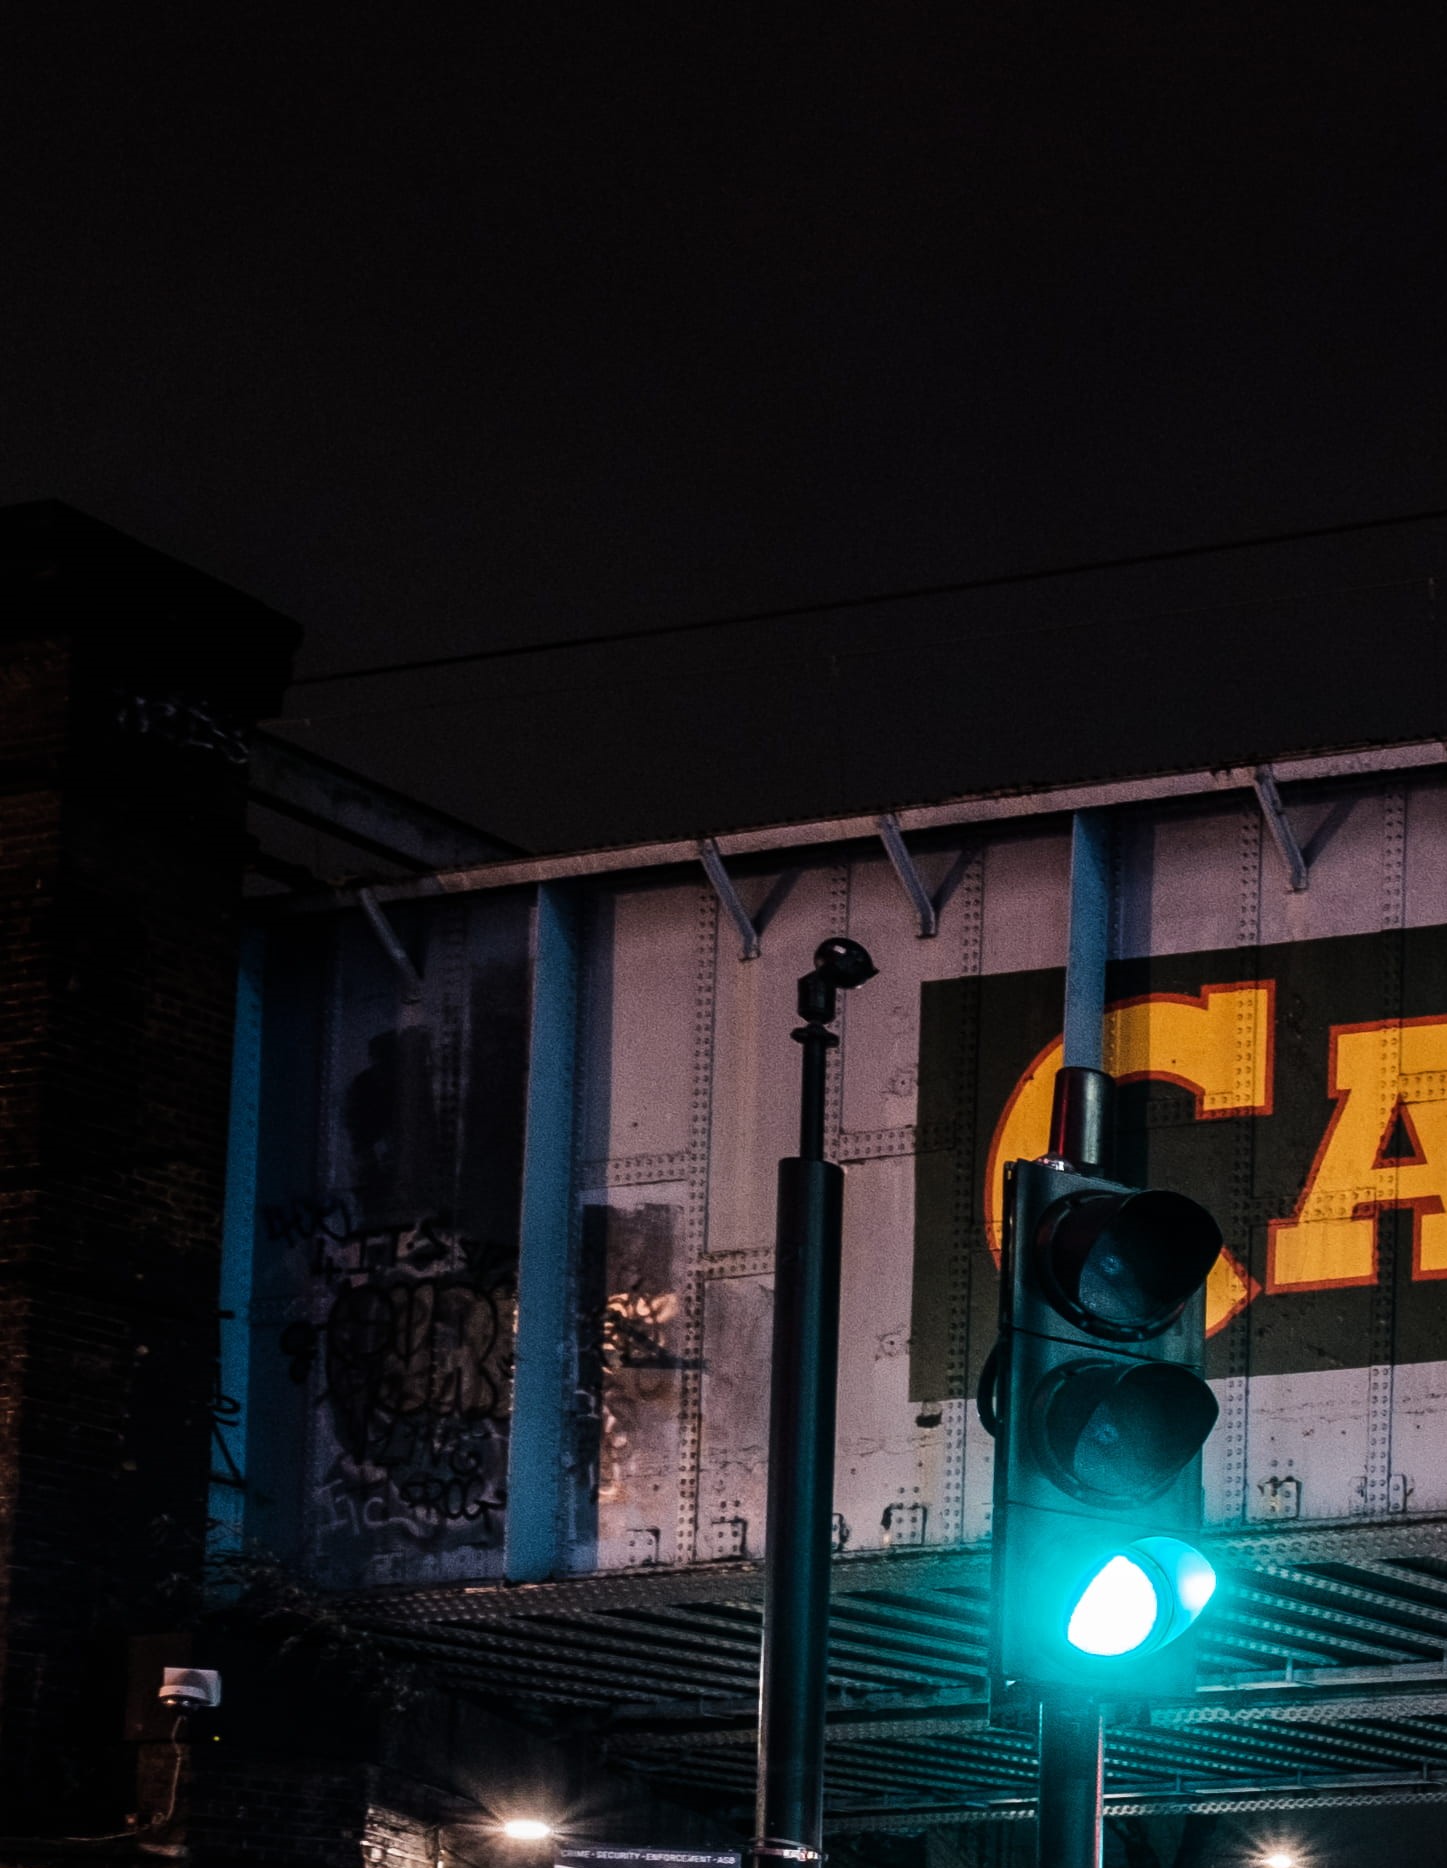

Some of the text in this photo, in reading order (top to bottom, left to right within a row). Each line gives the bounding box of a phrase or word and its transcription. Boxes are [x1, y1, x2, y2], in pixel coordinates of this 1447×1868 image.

[560, 1849, 591, 1859] CRIME
[596, 1851, 640, 1860] SECURITY
[645, 1853, 712, 1864] ENFORCEMENT
